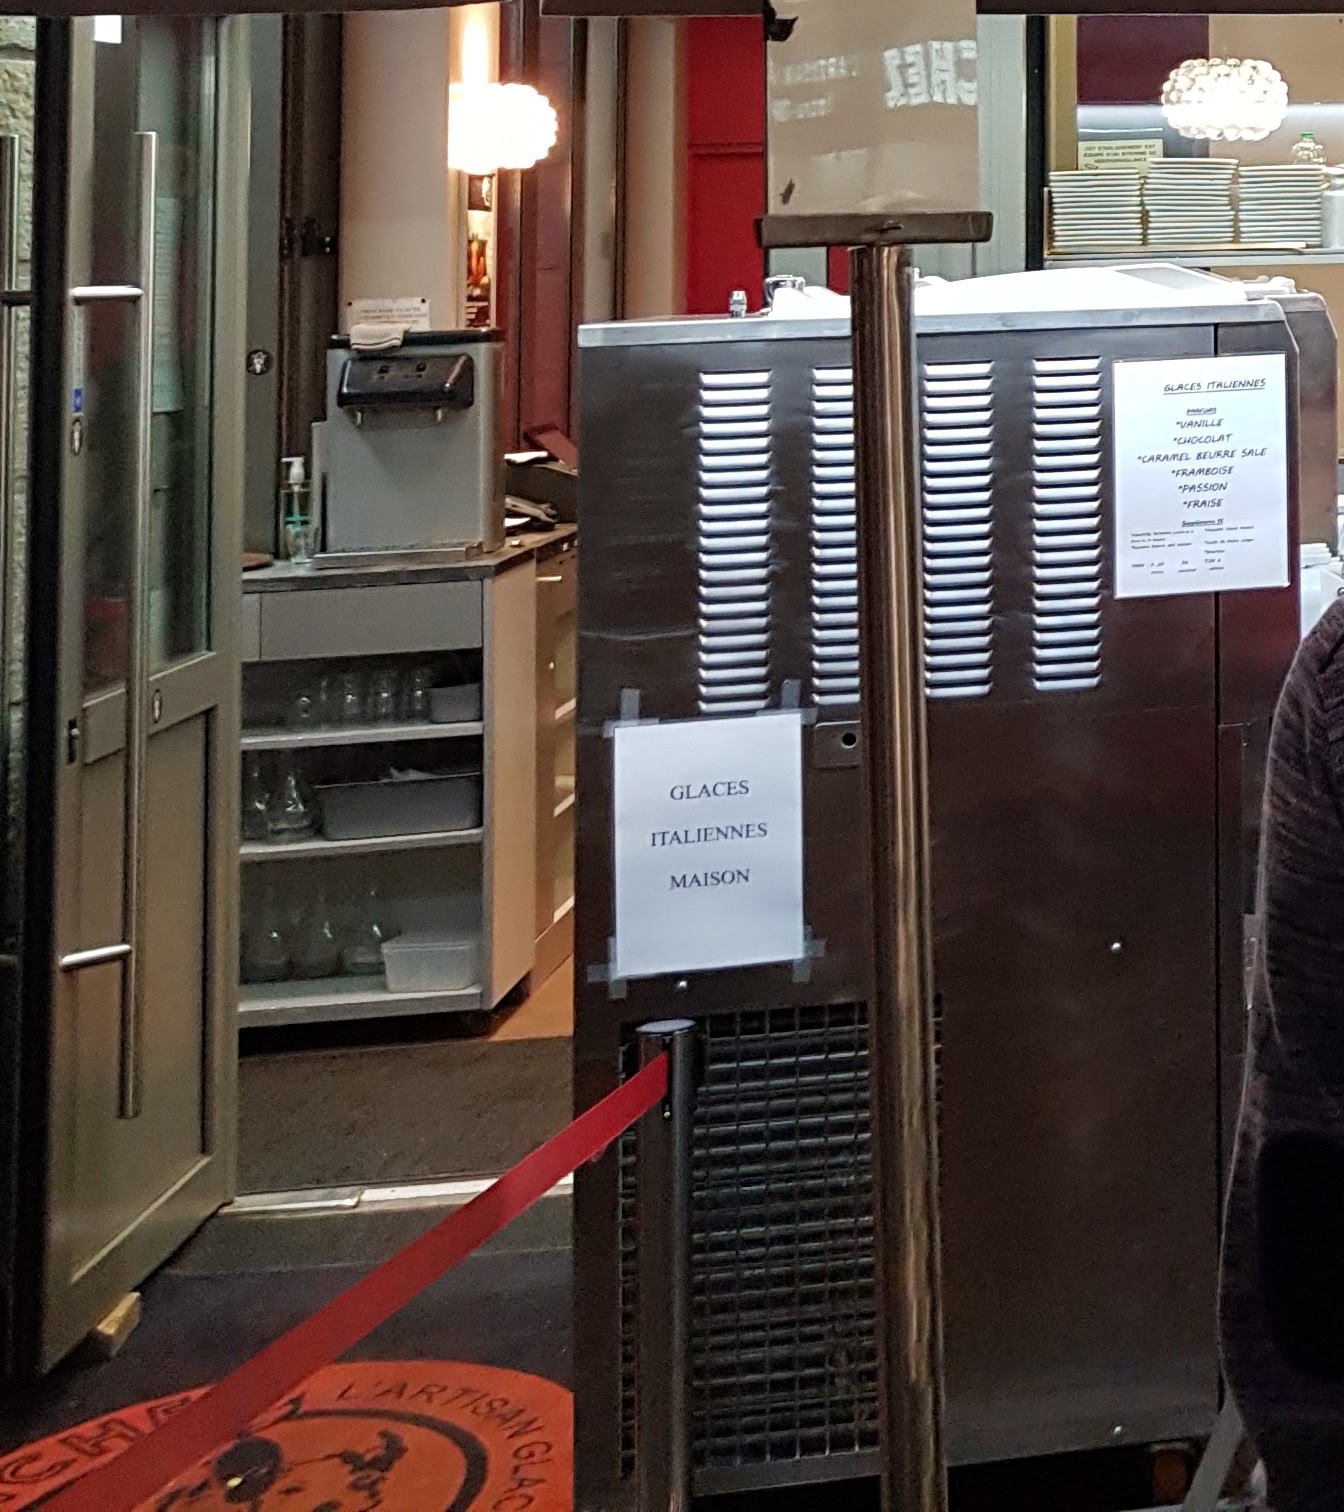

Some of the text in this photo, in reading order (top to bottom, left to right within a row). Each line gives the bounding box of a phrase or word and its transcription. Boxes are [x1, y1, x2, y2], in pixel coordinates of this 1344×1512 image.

[1163, 378, 1266, 392] GLACES ITALIENNES
[1180, 418, 1224, 428] VANILLE
[1177, 433, 1233, 445] CHOCOLAT
[1142, 452, 1191, 463] CARAMEL
[1175, 466, 1234, 478] FRAMBOISE
[1182, 481, 1228, 493] PASSION
[1187, 498, 1224, 509] FRAISE
[669, 779, 750, 801] GLACES
[651, 822, 768, 847] ITALIENNES
[669, 869, 750, 890] MAISON
